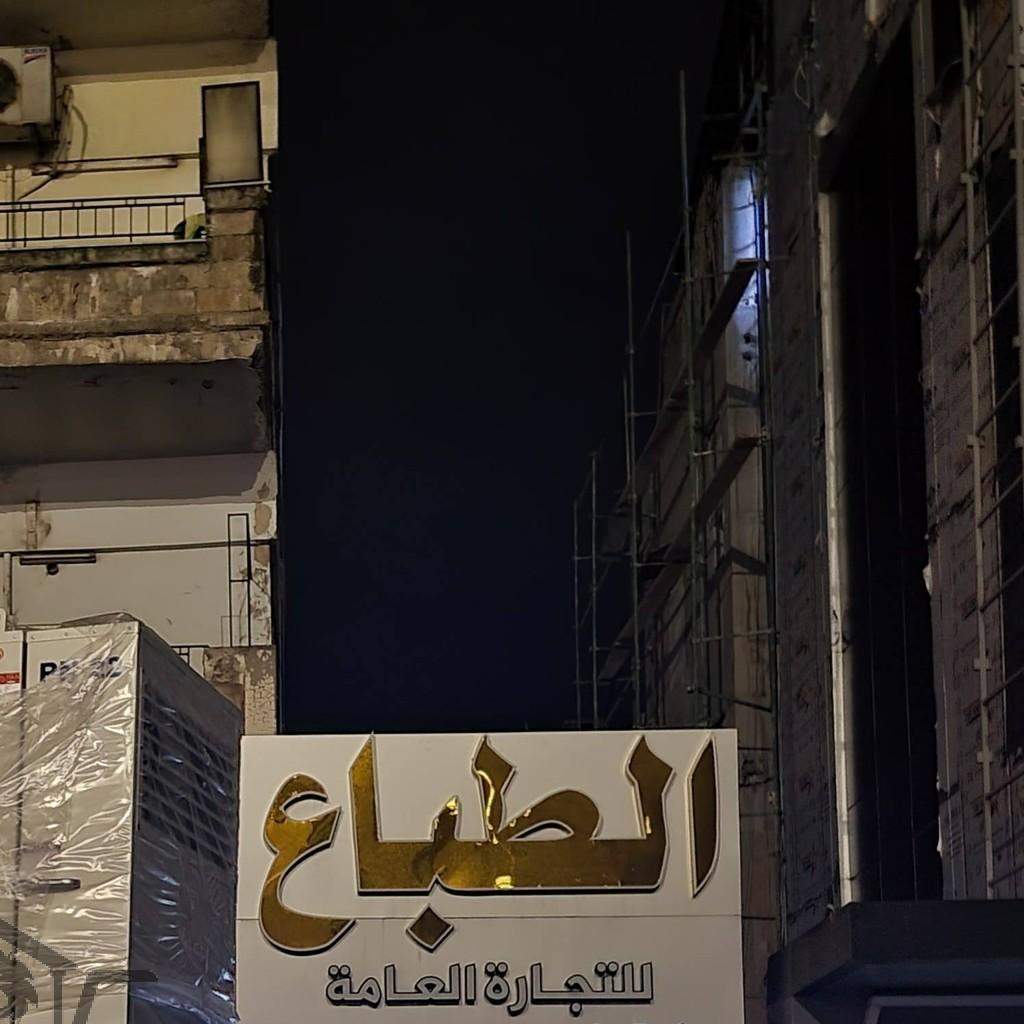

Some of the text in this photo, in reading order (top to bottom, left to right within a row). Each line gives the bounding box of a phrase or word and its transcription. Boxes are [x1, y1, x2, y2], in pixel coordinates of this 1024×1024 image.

[258, 732, 720, 955] الطباع
[325, 961, 653, 1017] للتجارة العامة
